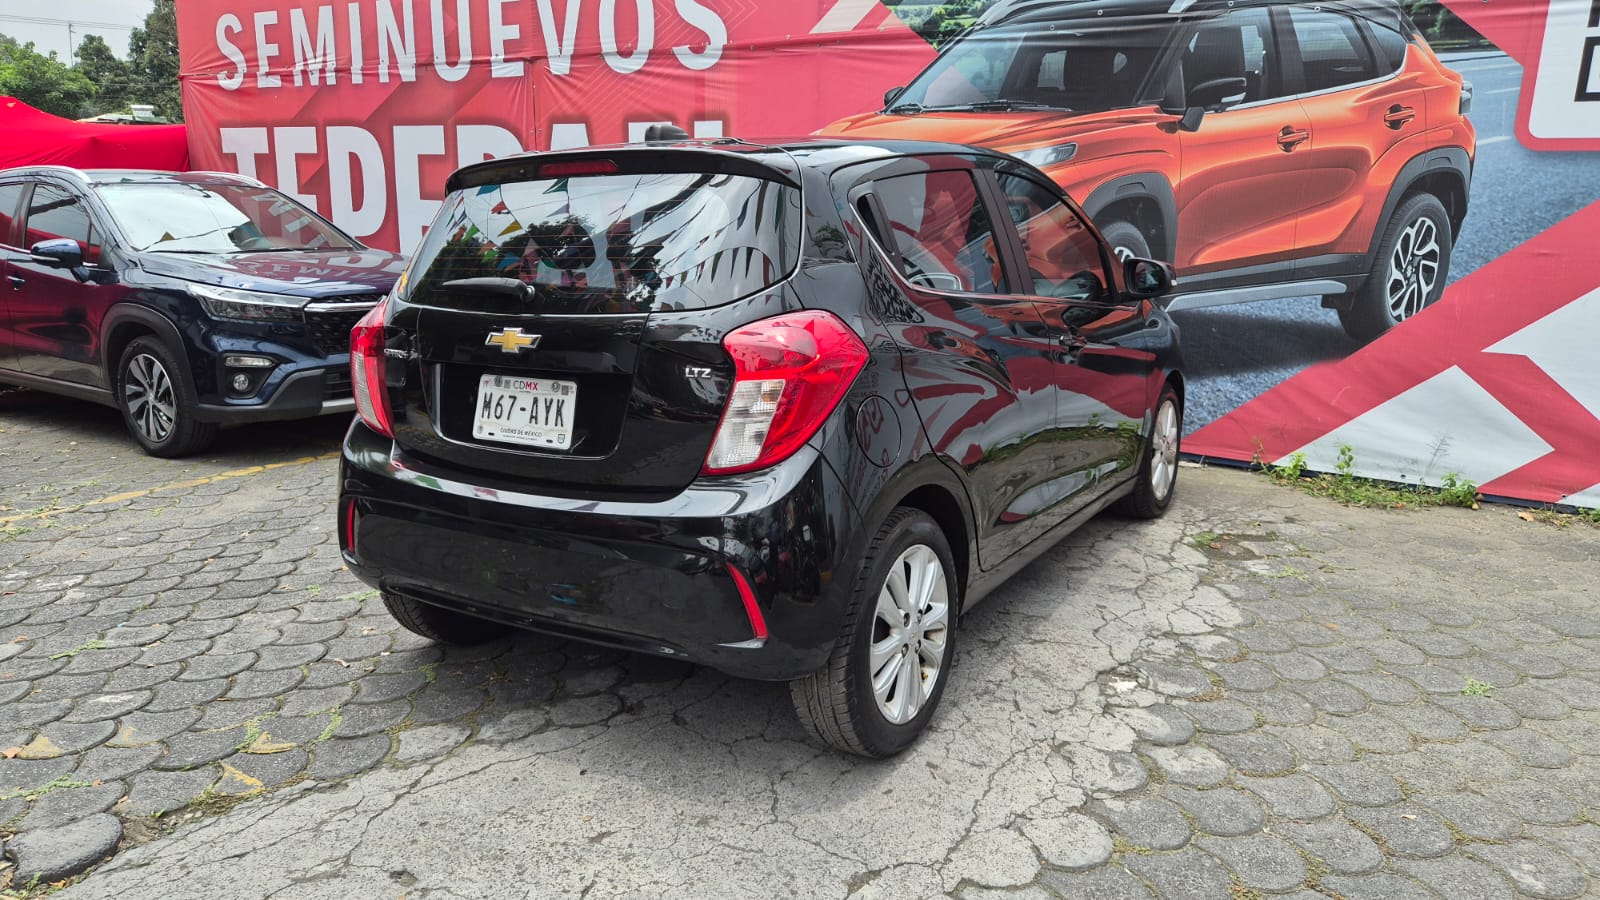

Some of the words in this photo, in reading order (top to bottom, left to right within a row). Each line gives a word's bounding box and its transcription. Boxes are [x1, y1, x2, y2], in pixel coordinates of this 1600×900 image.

[216, 0, 729, 91] SEMINUEVOS
[685, 367, 712, 378] LTZ
[513, 380, 539, 391] CDMX
[480, 391, 566, 427] M67-AYK
